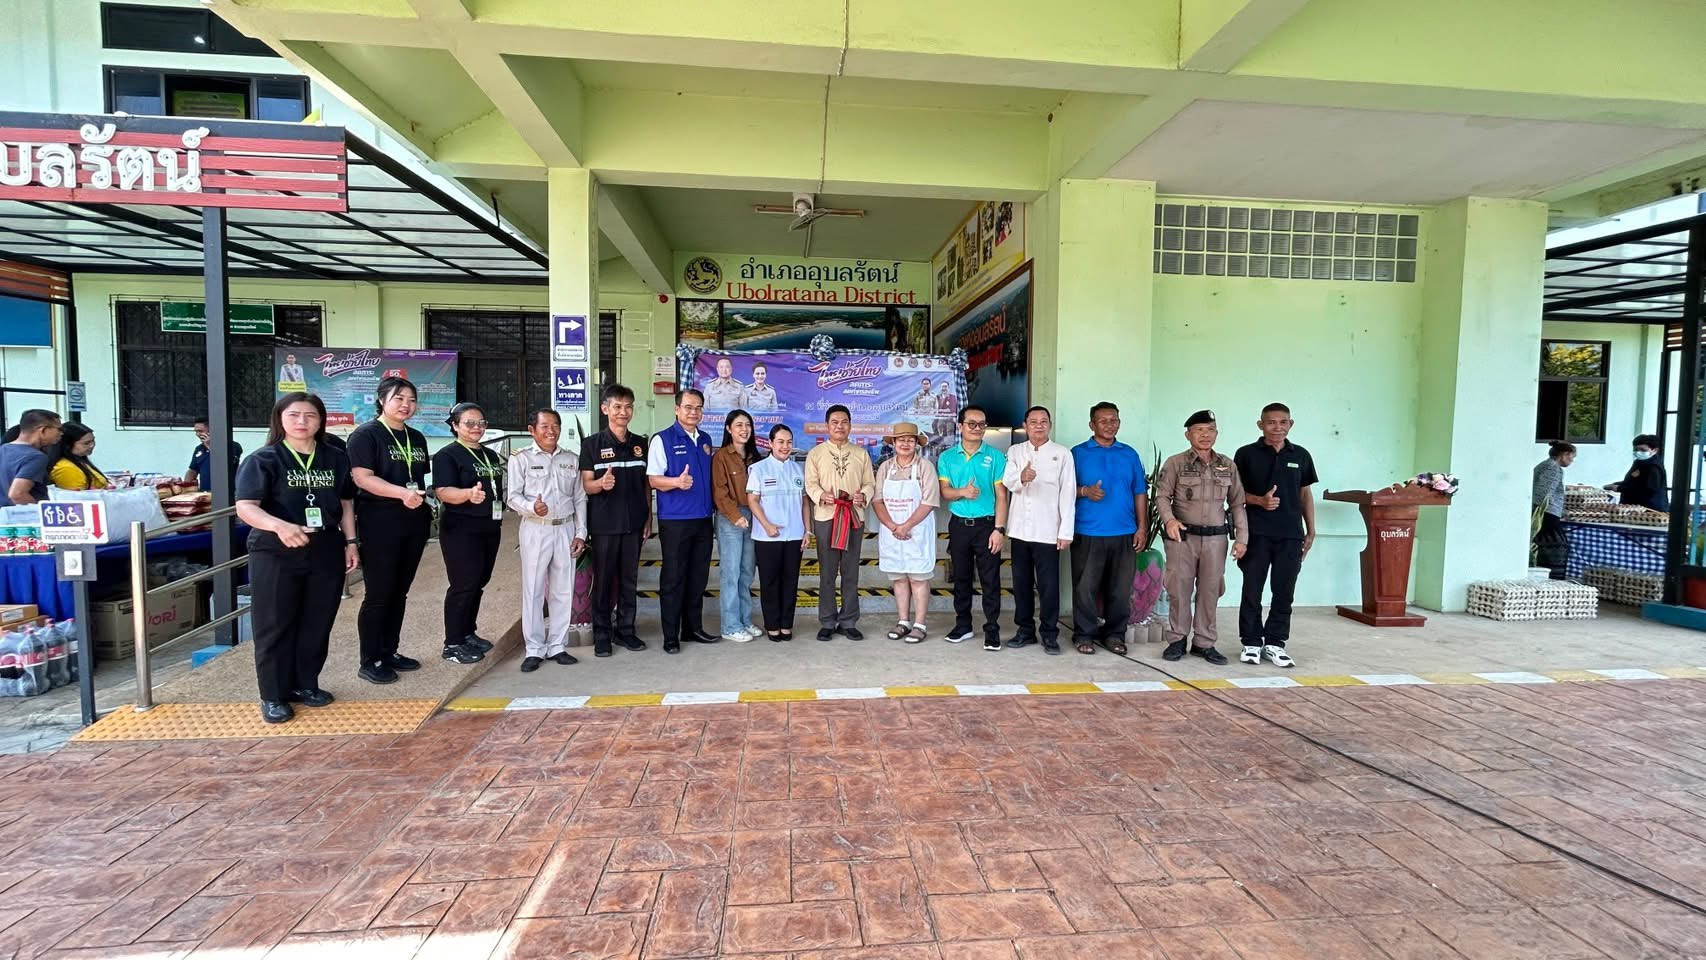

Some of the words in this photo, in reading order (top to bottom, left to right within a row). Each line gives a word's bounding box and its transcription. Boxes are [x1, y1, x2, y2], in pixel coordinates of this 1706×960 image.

[740, 257, 901, 289] อำเภออุบลรัตน์
[726, 282, 837, 303] Ubolratana
[844, 286, 917, 305] District
